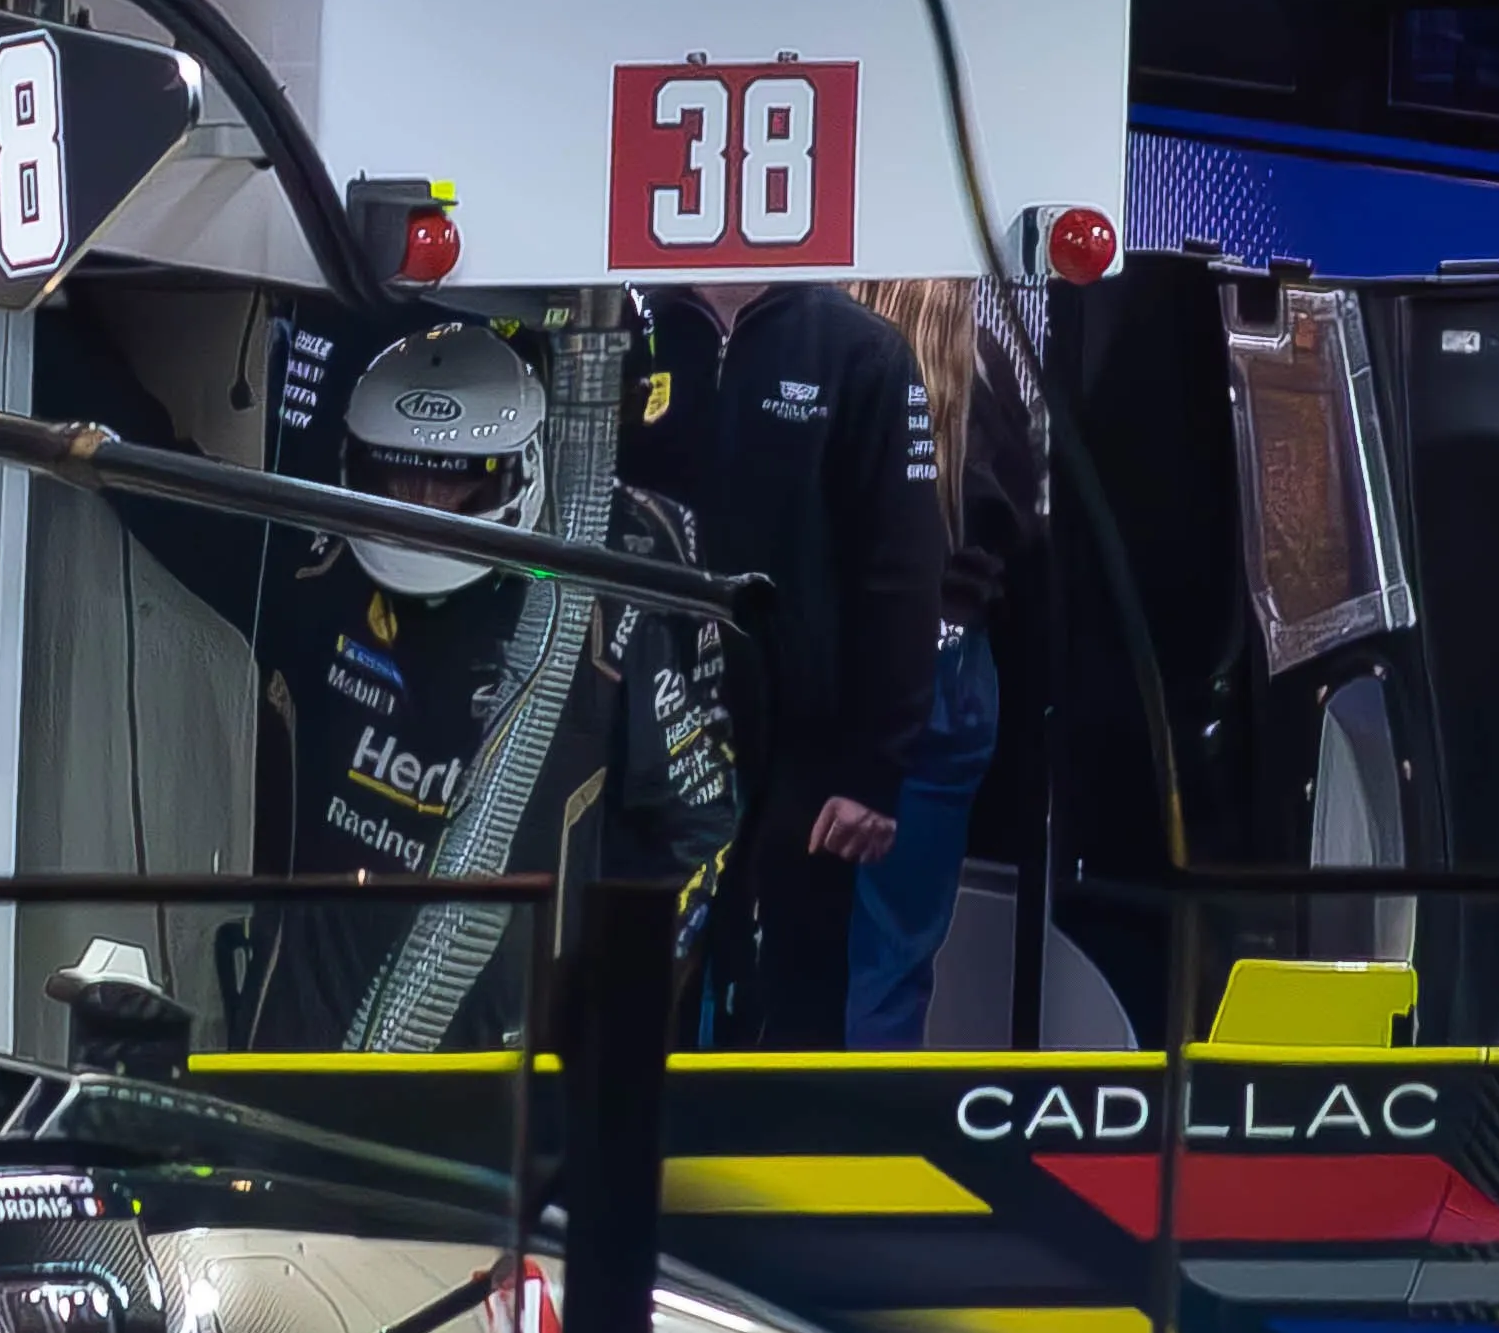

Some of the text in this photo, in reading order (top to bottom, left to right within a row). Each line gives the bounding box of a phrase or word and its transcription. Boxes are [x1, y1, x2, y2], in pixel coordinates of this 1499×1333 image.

[649, 77, 817, 248] 38
[351, 724, 463, 804] Hert
[326, 794, 427, 871] Racing
[956, 1081, 1440, 1141] CADLLAC
